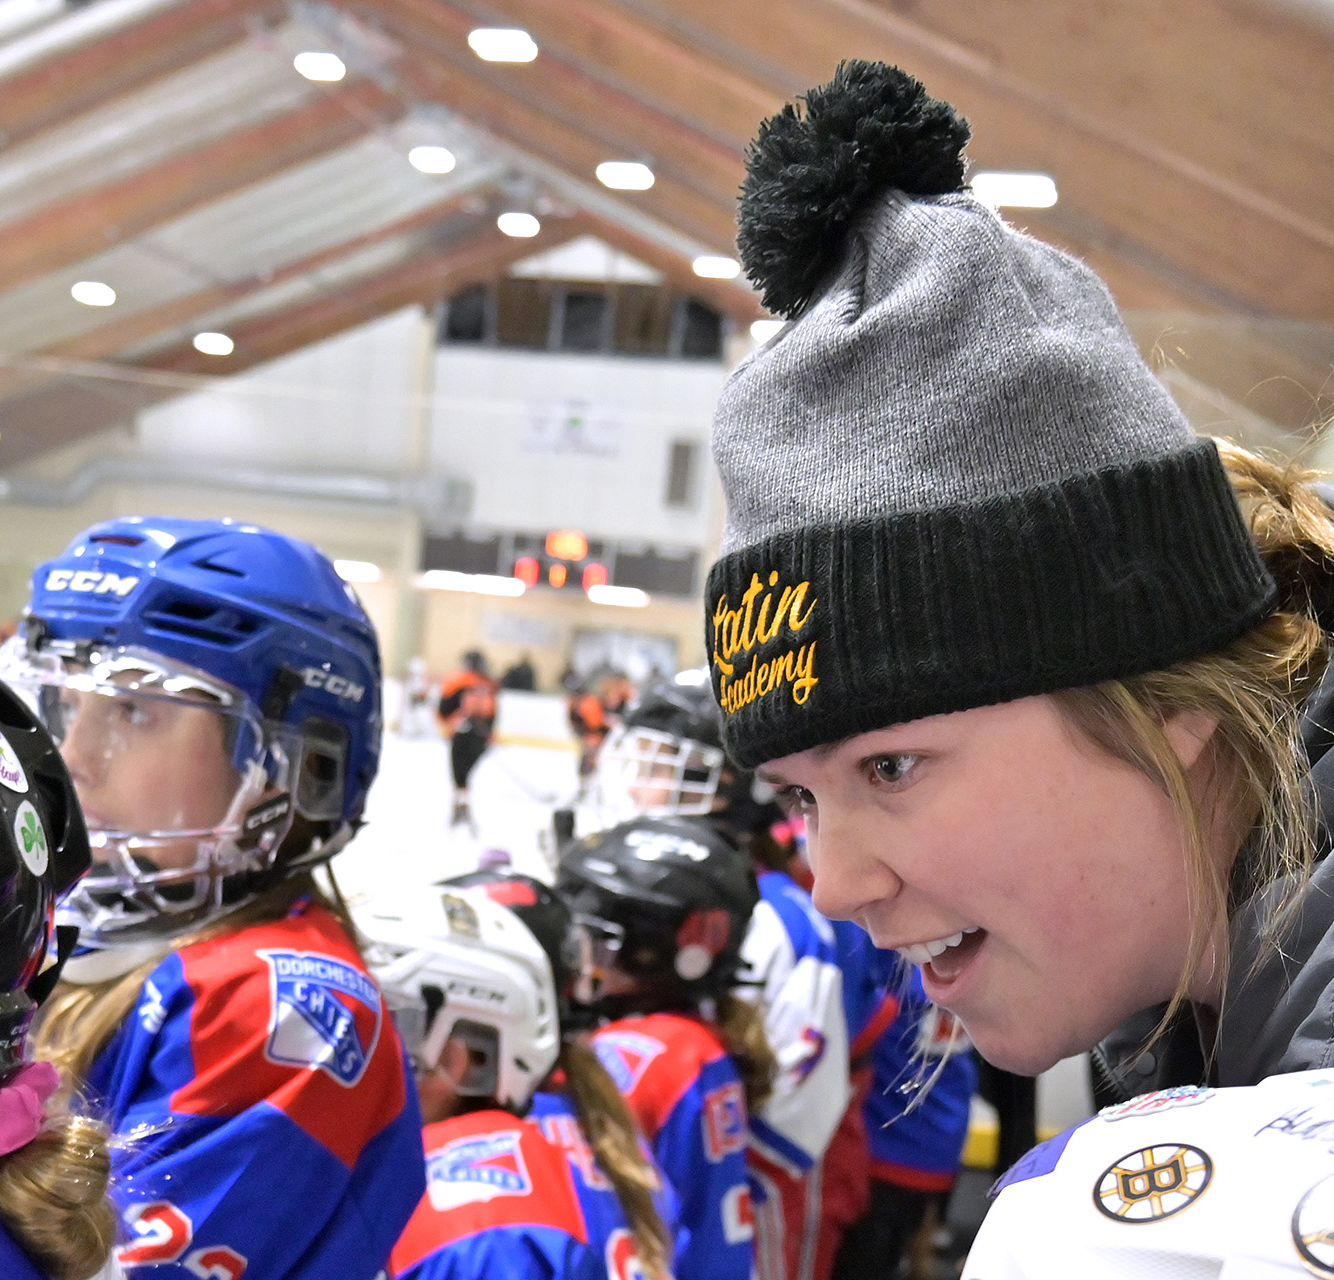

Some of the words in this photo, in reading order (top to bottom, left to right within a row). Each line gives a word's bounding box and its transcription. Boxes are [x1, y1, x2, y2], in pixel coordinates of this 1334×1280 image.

[46, 569, 140, 596] CCM
[713, 570, 817, 676] Latin
[301, 667, 365, 702] CCM
[720, 641, 818, 715] Academy
